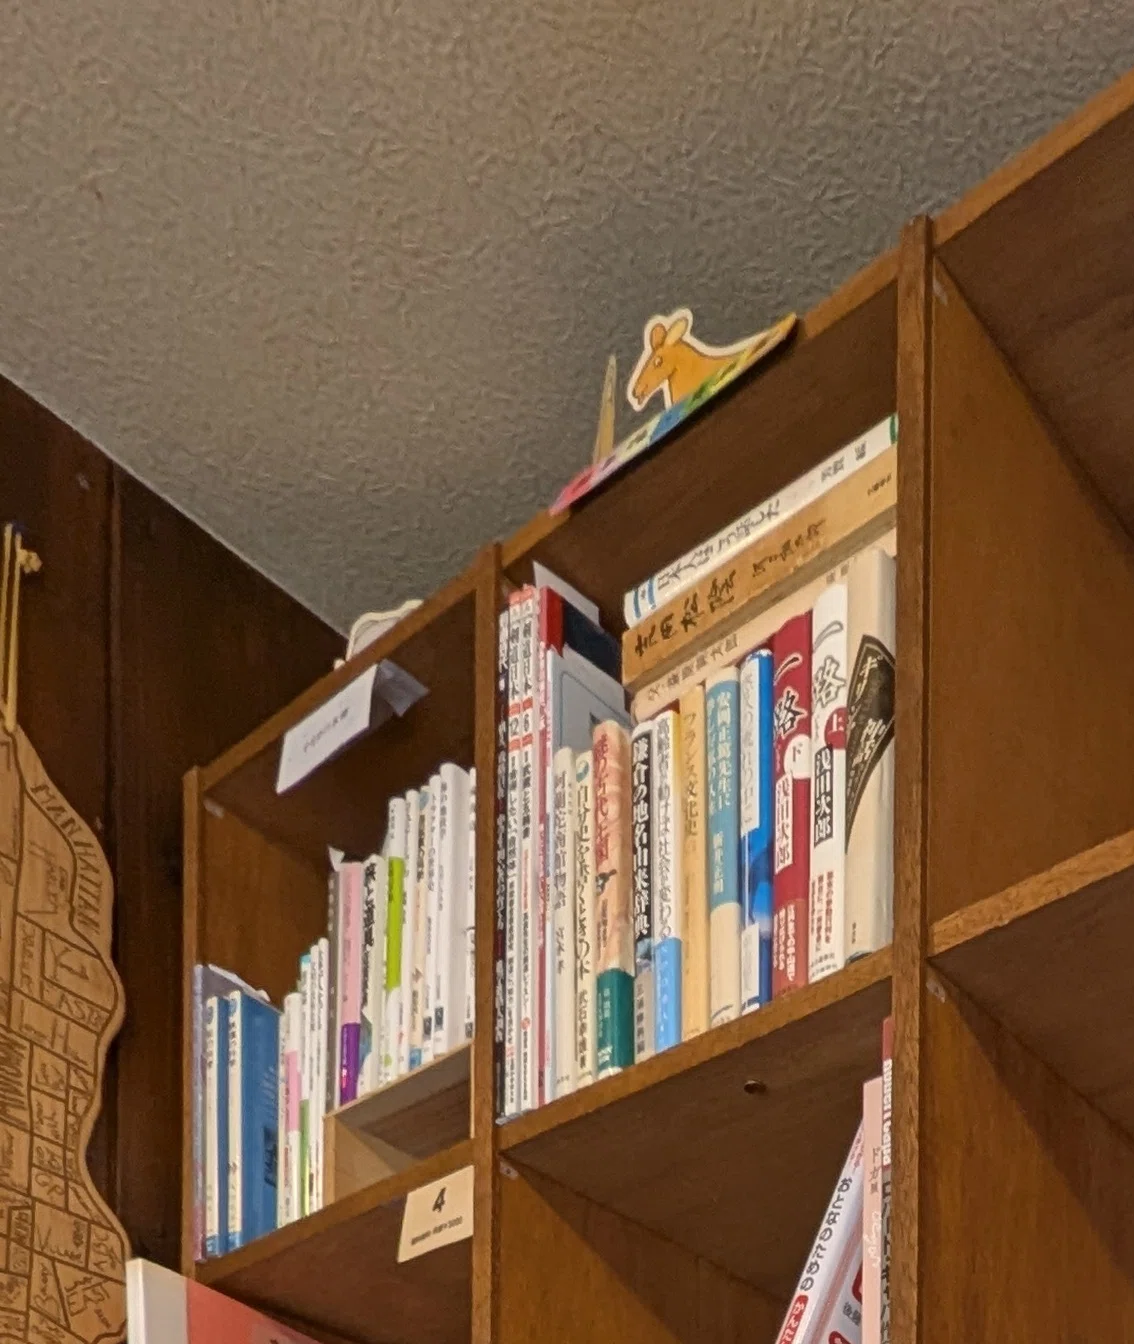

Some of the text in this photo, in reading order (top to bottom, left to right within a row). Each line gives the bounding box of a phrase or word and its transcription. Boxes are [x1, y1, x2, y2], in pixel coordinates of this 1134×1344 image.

[634, 569, 737, 658] 吉田松陰
[773, 655, 807, 739] 一路
[813, 620, 848, 709] 一路
[814, 748, 833, 843] 浅田次郎
[432, 1186, 447, 1213] 4
[800, 1177, 853, 1292] おとなのための
